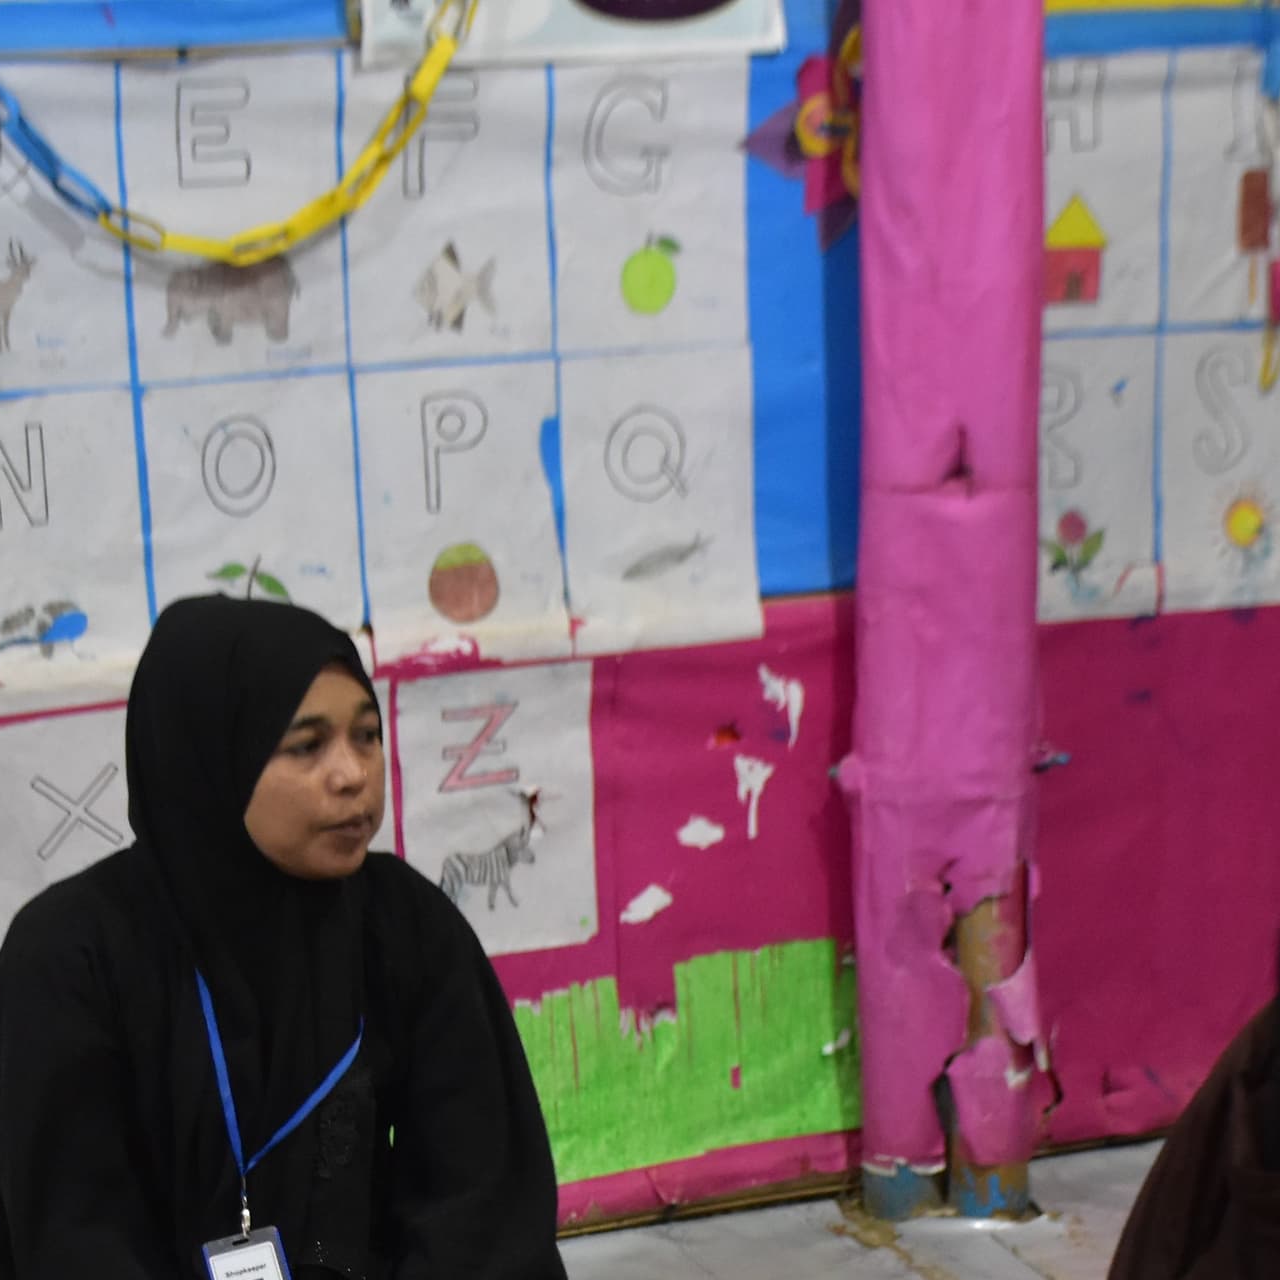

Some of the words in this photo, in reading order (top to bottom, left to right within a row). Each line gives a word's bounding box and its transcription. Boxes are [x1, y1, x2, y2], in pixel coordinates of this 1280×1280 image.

[175, 78, 251, 190] E
[403, 72, 480, 200] F
[582, 73, 672, 196] G
[1044, 55, 1106, 153] H
[201, 413, 276, 517] O
[420, 392, 488, 514] P
[604, 404, 689, 503] Q
[1194, 348, 1250, 473] S
[30, 762, 124, 862] X
[438, 701, 519, 793] Z
